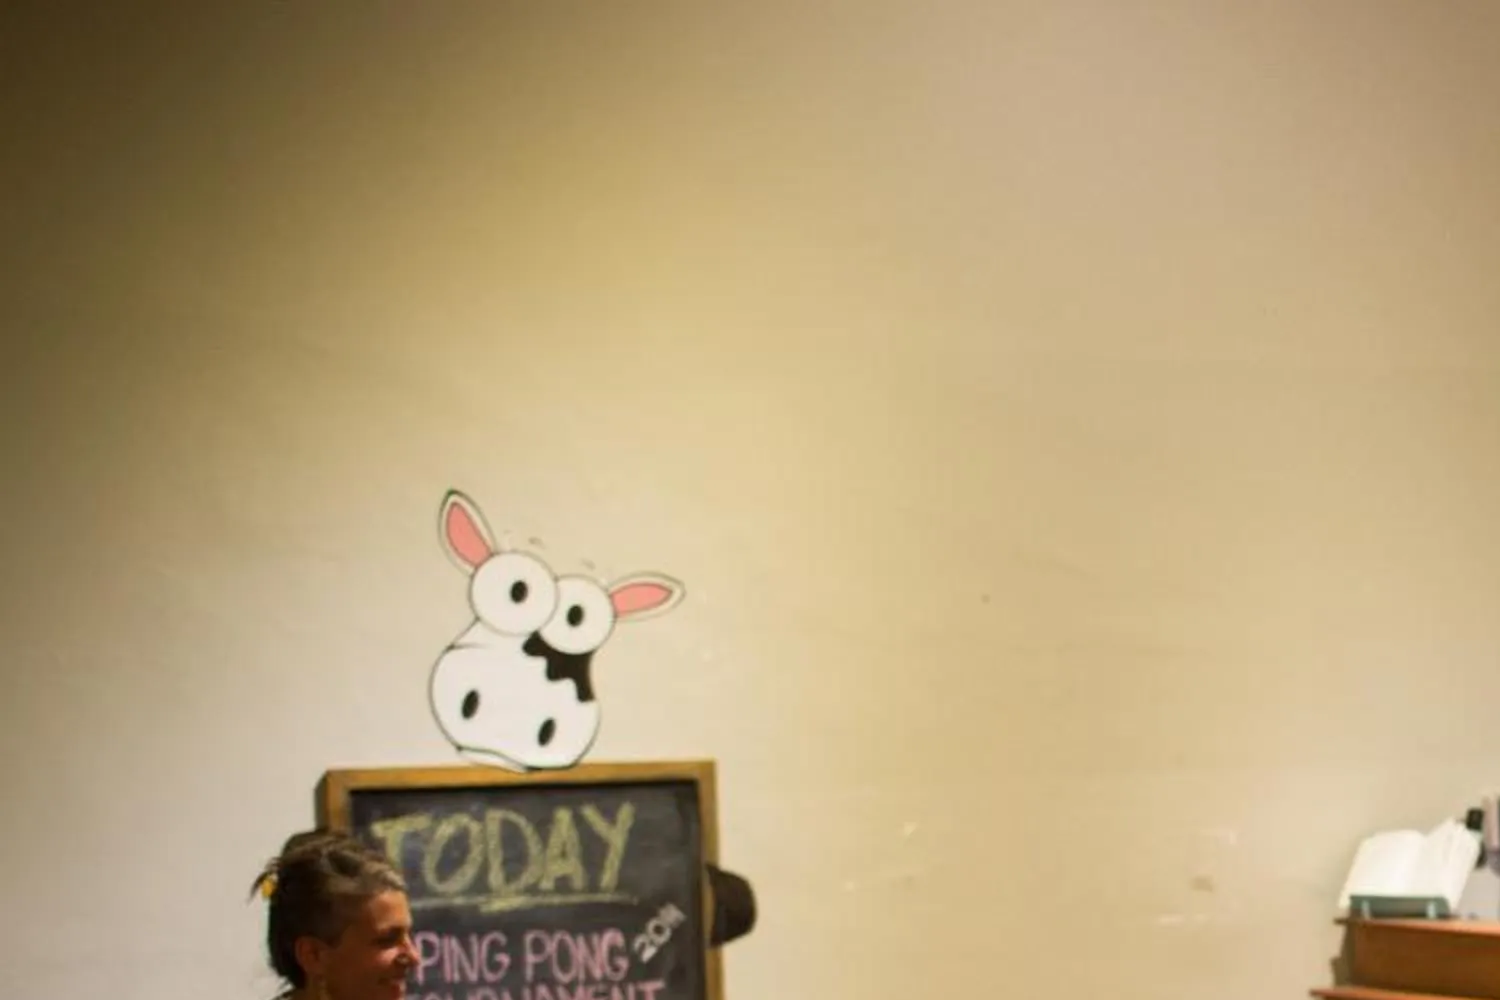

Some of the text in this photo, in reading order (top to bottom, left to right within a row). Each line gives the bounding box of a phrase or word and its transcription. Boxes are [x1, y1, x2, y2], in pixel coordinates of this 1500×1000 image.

[371, 803, 636, 893] TODAY
[415, 928, 630, 984] PING PONG
